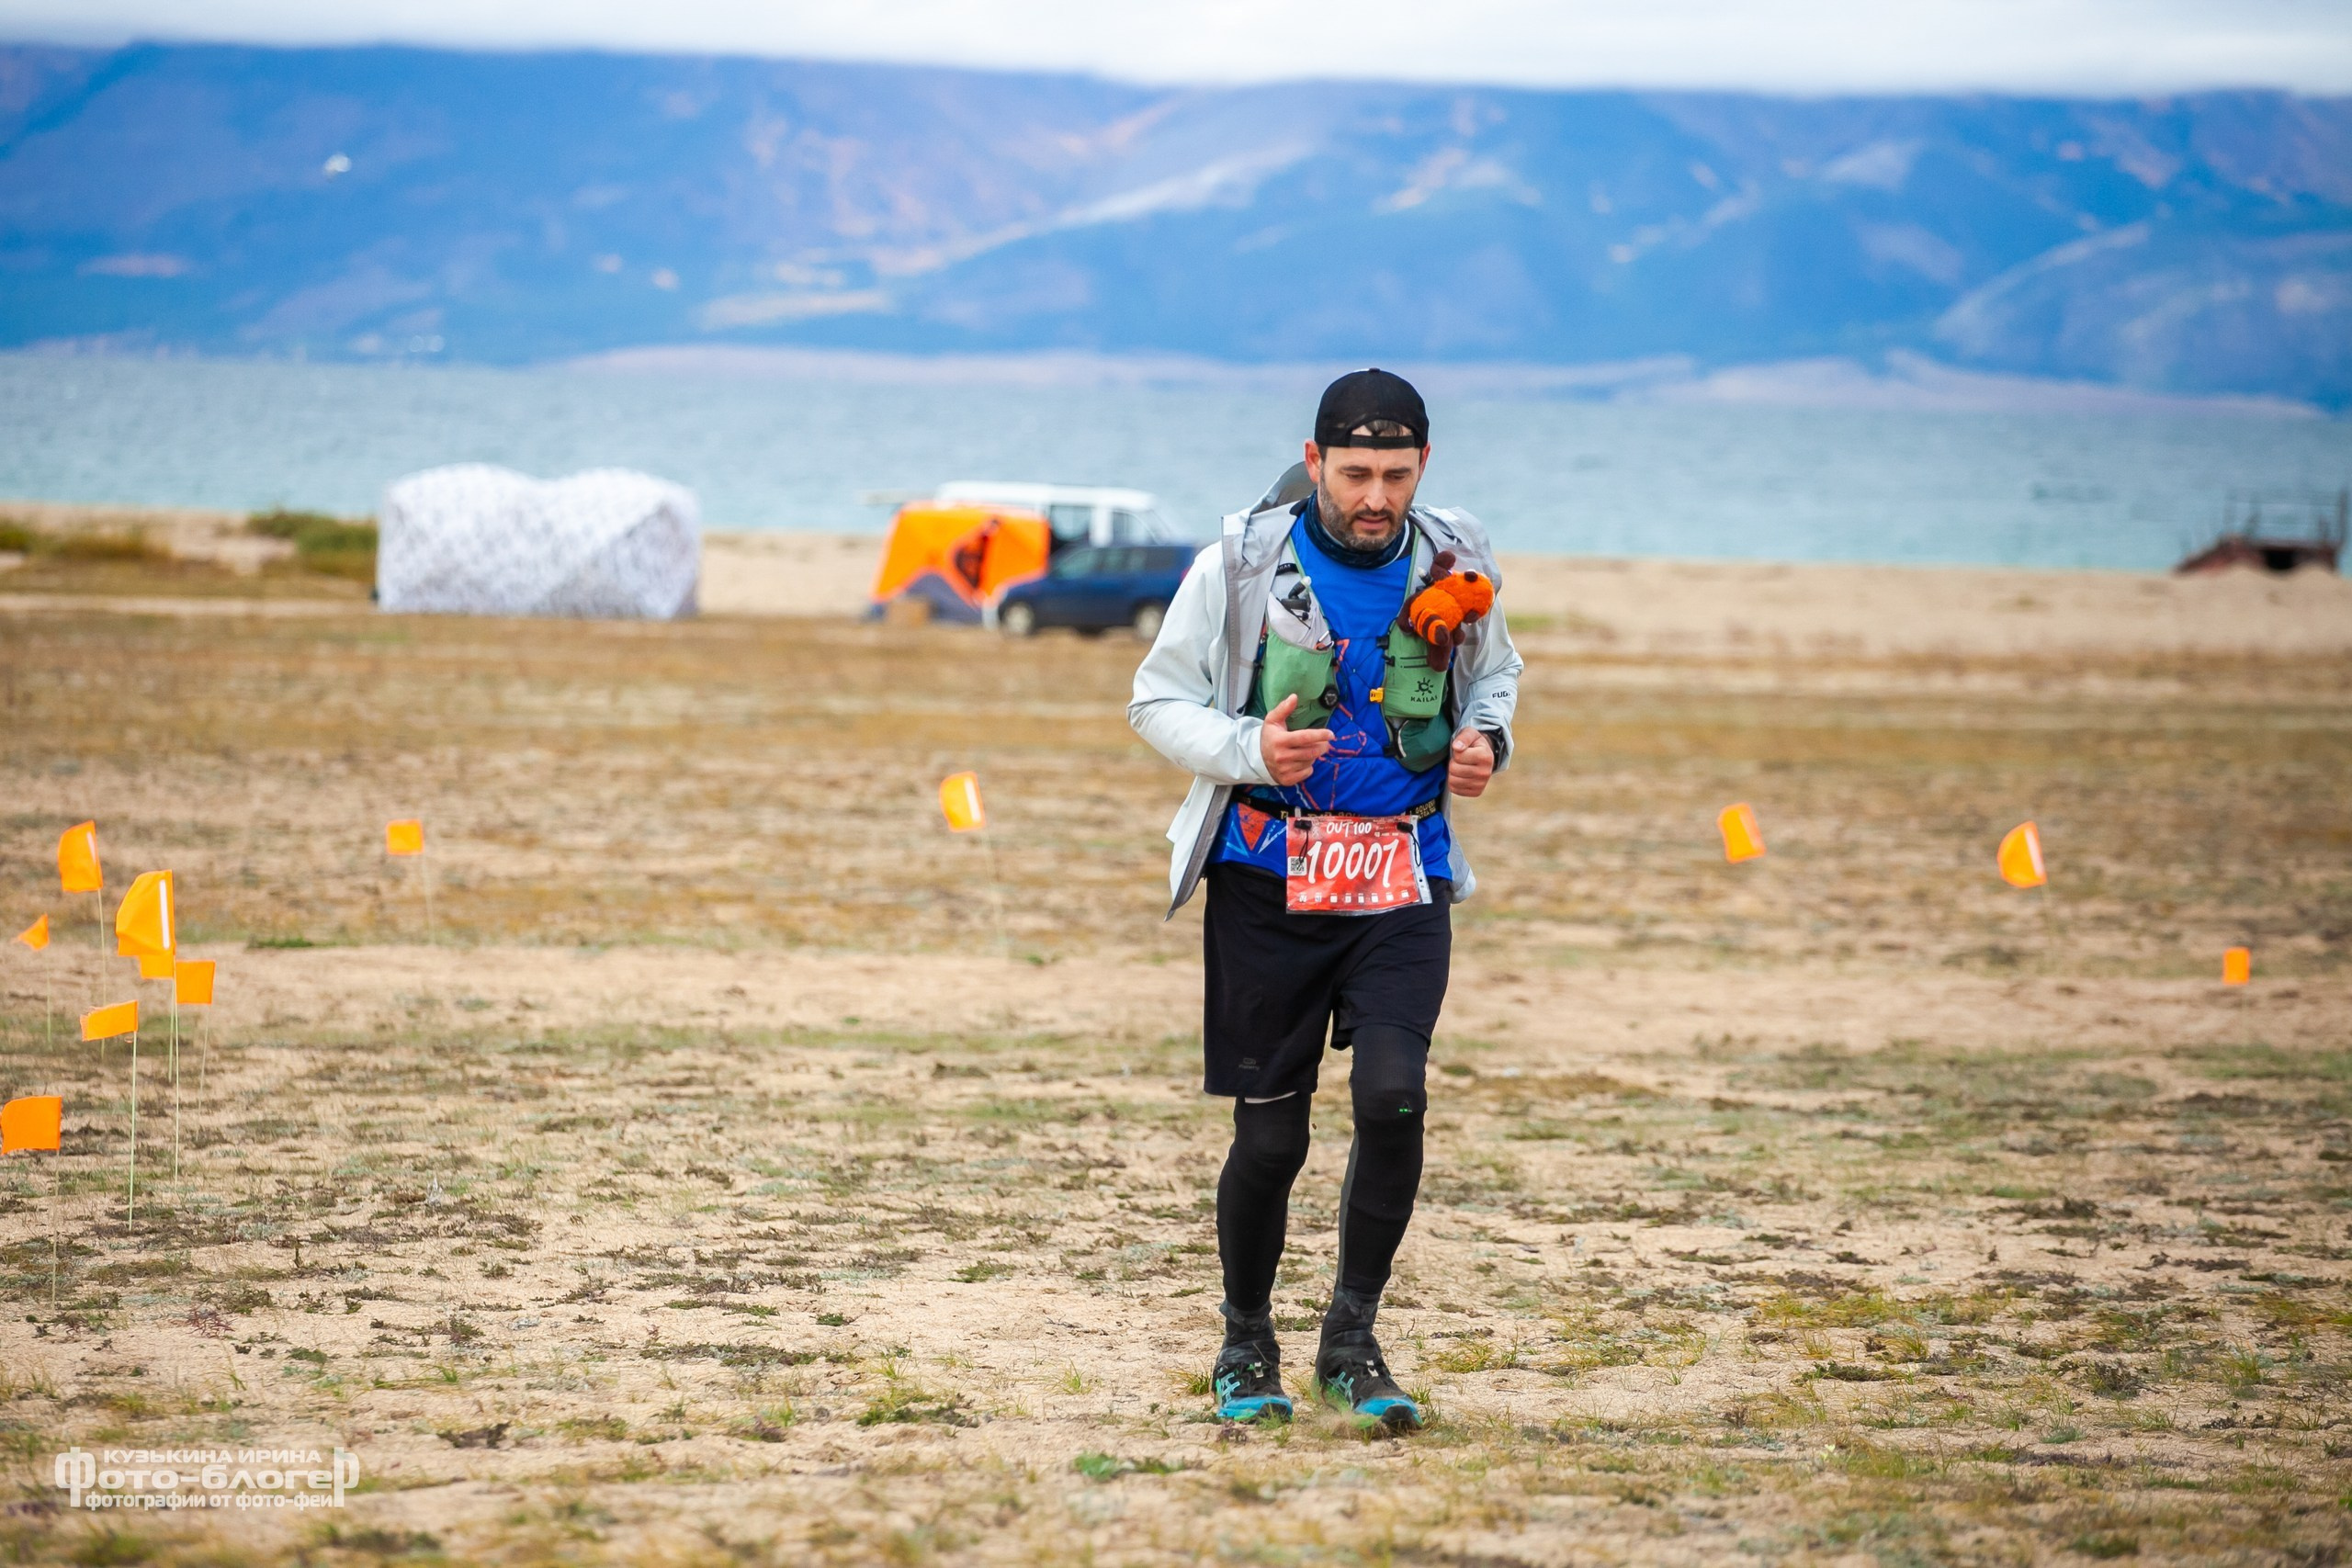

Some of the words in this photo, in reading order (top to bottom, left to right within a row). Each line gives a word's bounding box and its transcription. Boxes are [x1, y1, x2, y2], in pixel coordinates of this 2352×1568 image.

[1327, 822, 1353, 838] OUT
[1353, 822, 1372, 835] 100
[1306, 839, 1399, 888] 10007
